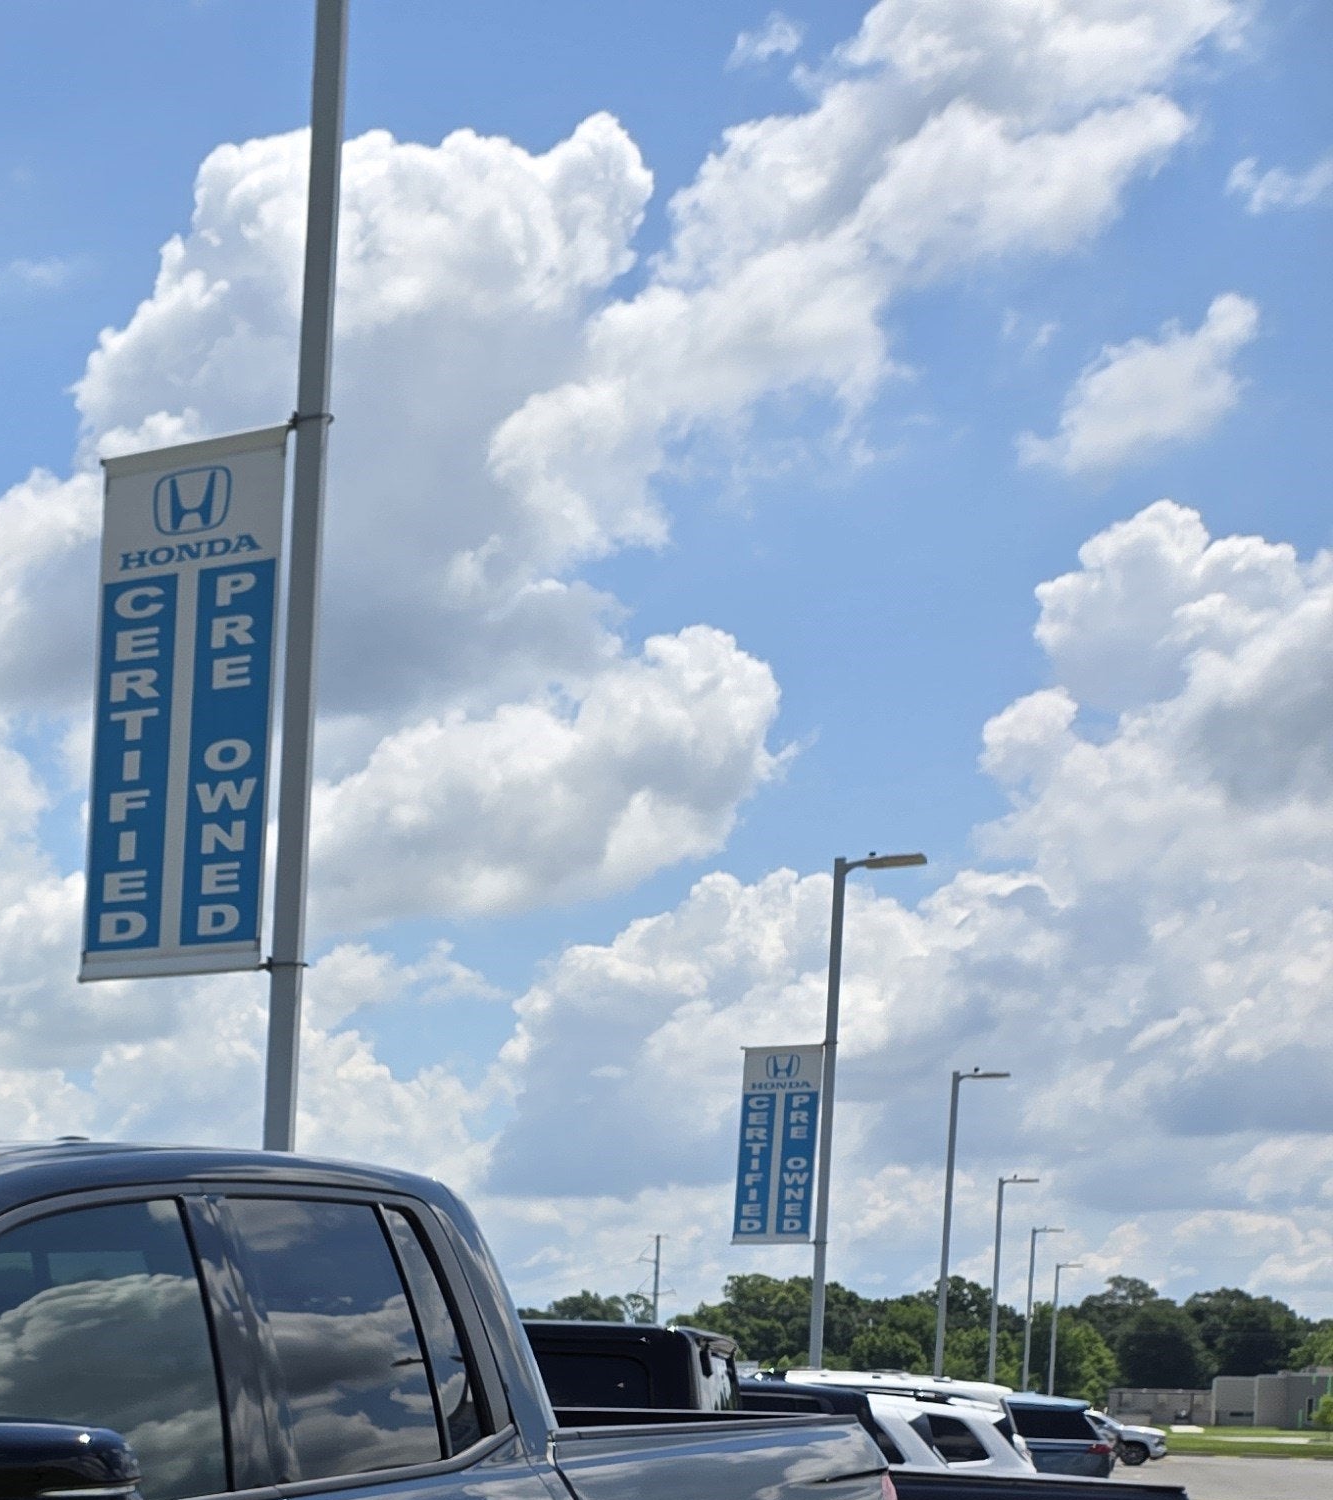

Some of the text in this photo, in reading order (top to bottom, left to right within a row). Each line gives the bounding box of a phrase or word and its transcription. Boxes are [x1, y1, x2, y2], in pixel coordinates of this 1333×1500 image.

[119, 533, 262, 571] HONDA
[98, 585, 166, 944] CERTIFIED
[195, 571, 258, 937] PRE OWNED
[750, 1080, 812, 1091] HONDA
[739, 1096, 769, 1232] CERTIFIED
[783, 1094, 810, 1232] PRE OWNED
